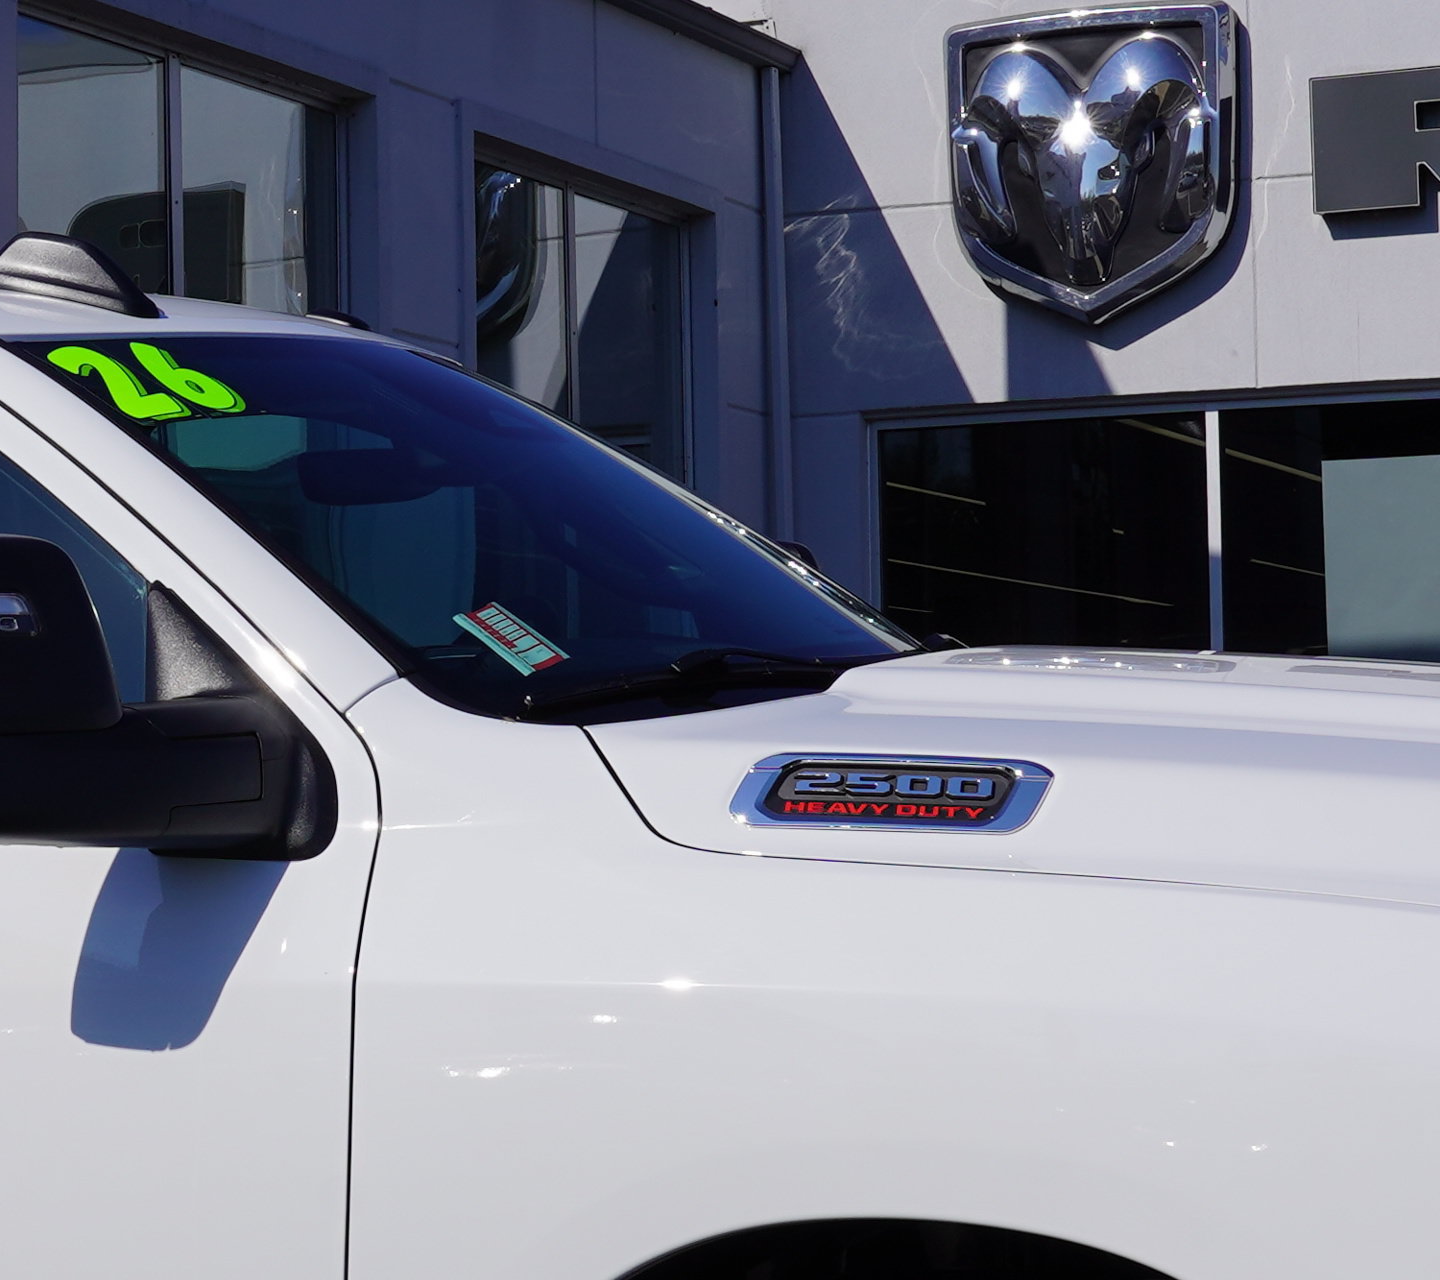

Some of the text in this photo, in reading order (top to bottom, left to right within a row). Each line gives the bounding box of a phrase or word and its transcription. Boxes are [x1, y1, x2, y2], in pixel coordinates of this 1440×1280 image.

[47, 341, 247, 421] 26
[793, 771, 996, 802] 2500
[783, 800, 985, 819] HEAVY DUTY
